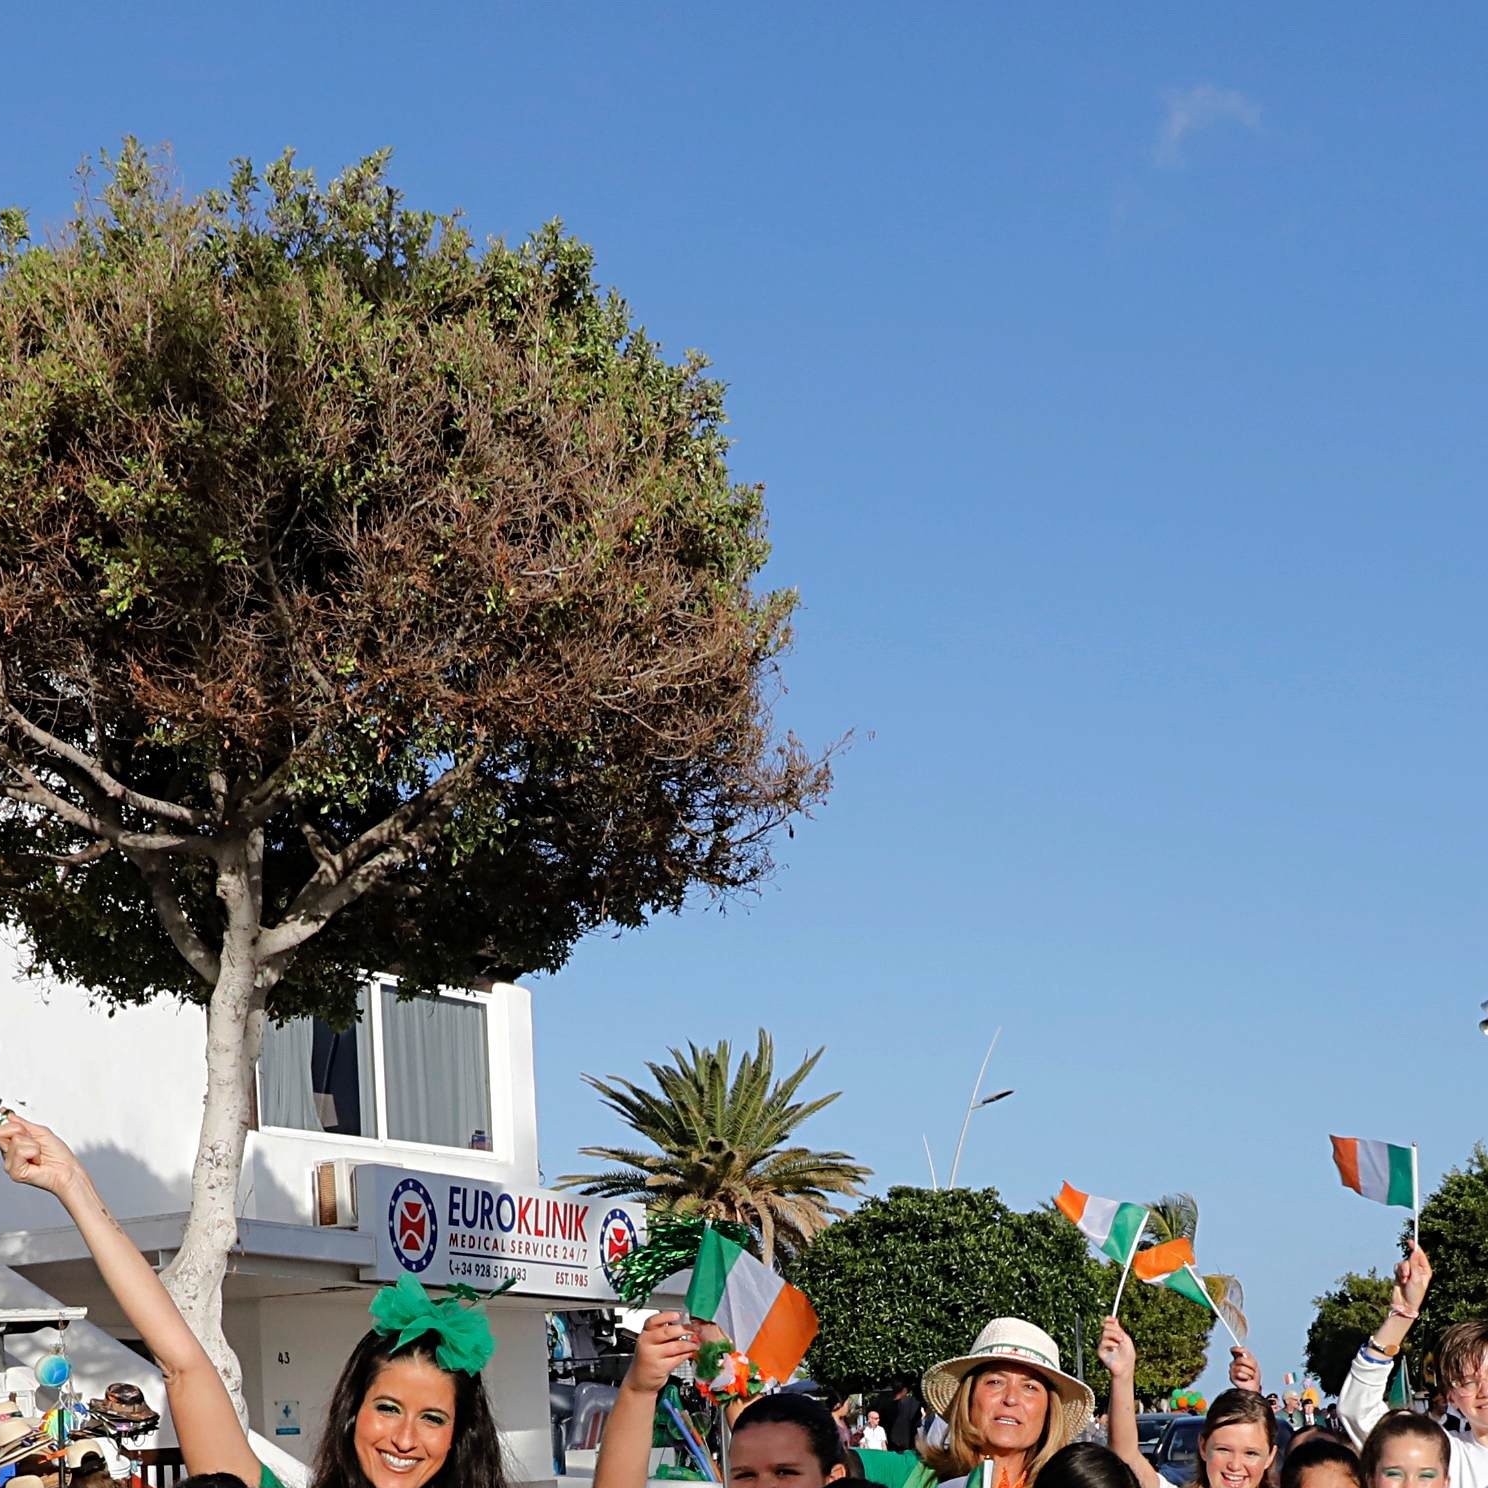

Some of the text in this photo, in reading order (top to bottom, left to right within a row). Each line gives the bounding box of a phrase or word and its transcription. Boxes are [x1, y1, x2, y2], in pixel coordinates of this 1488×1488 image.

[448, 1186, 589, 1242] EUROKLINIK
[449, 1233, 588, 1262] MEDICAL SERVICE 24/7
[455, 1261, 527, 1281] +34 928 512 083
[555, 1272, 589, 1287] EST.1985
[278, 1351, 290, 1364] 43
